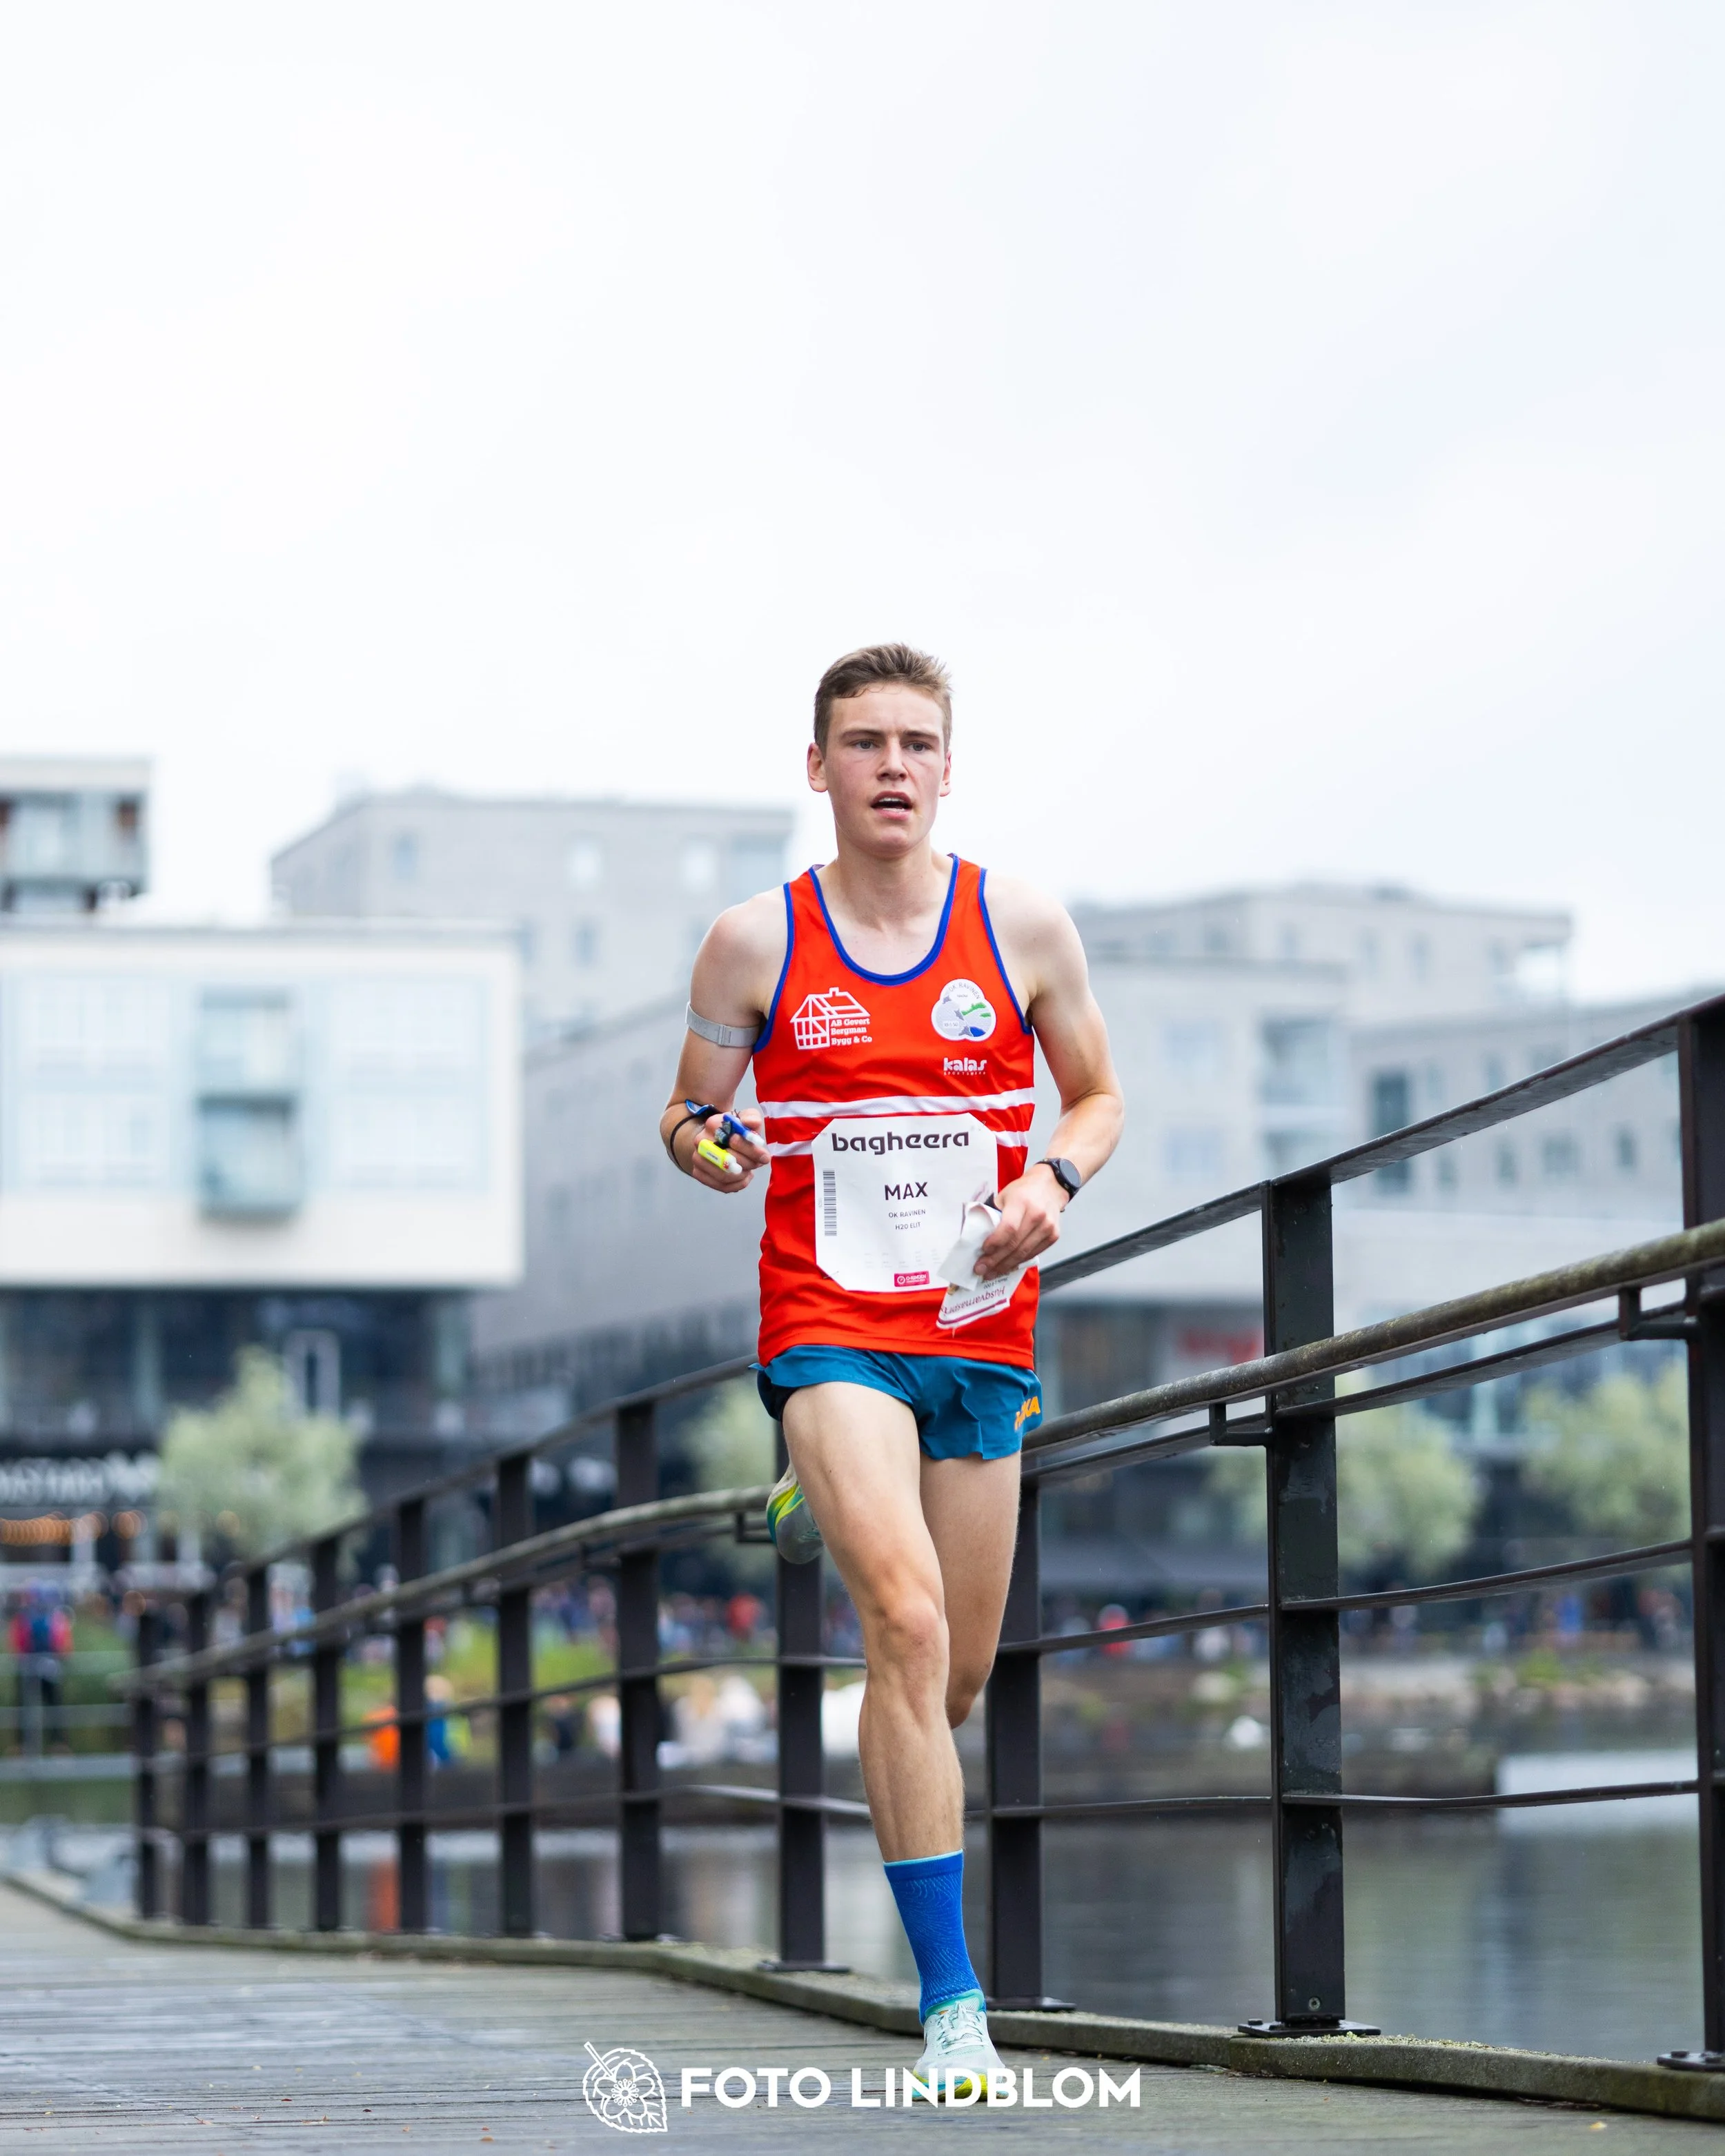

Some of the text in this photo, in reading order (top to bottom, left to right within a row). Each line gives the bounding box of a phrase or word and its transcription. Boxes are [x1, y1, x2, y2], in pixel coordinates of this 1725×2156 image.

[830, 1018, 871, 1027] AB Gevert
[830, 1027, 867, 1036] Bergman
[831, 1035, 873, 1047] Bygg & Co
[943, 1057, 987, 1071] kalas
[831, 1131, 969, 1155] bagheera
[884, 1181, 929, 1200] MAX
[900, 1209, 926, 1218] RAVINEN
